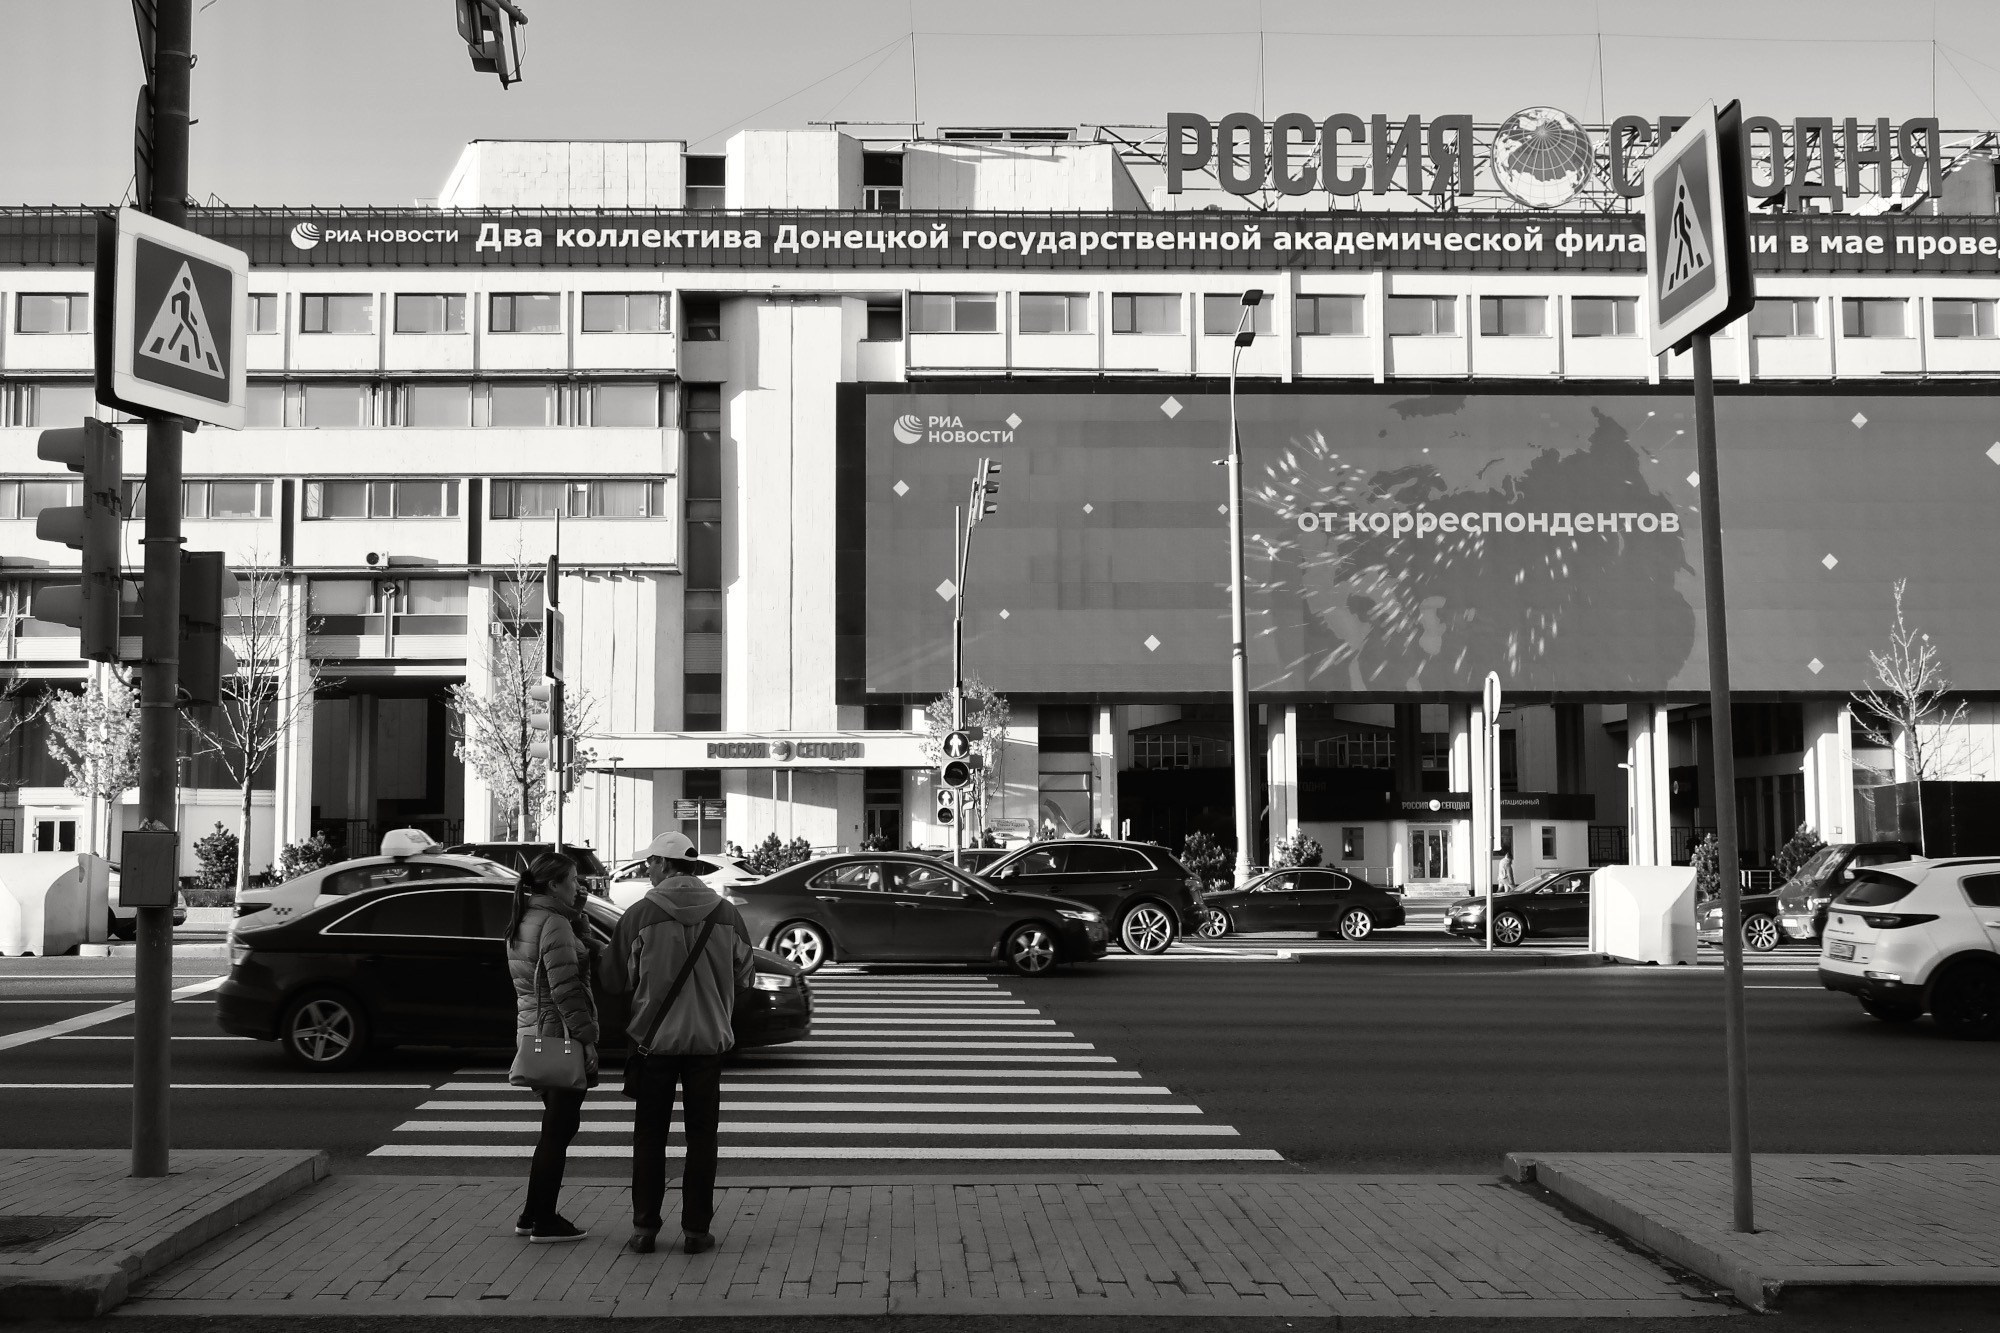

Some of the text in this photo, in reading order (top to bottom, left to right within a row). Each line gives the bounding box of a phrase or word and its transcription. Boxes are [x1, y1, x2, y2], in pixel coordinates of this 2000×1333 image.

[1167, 112, 1943, 212] РОССИЯ СОДНЯ
[326, 230, 459, 243] РИА НОВОСТИ
[476, 223, 542, 252] Два
[557, 229, 761, 249] коллектива
[774, 223, 948, 253] Донецкой
[963, 225, 1260, 255] государственной
[1274, 226, 1542, 255] академической
[1791, 235, 1809, 254] в
[1821, 235, 1884, 254] мае
[1896, 235, 2000, 260] прове
[929, 416, 1014, 443] РИА НОВОСТИ
[1299, 511, 1679, 539] от корреспондентов
[707, 742, 862, 761] РОССИЯ СЕГОДНЯ
[1402, 801, 1470, 811] РОССИЯ СЕГОДНЯ
